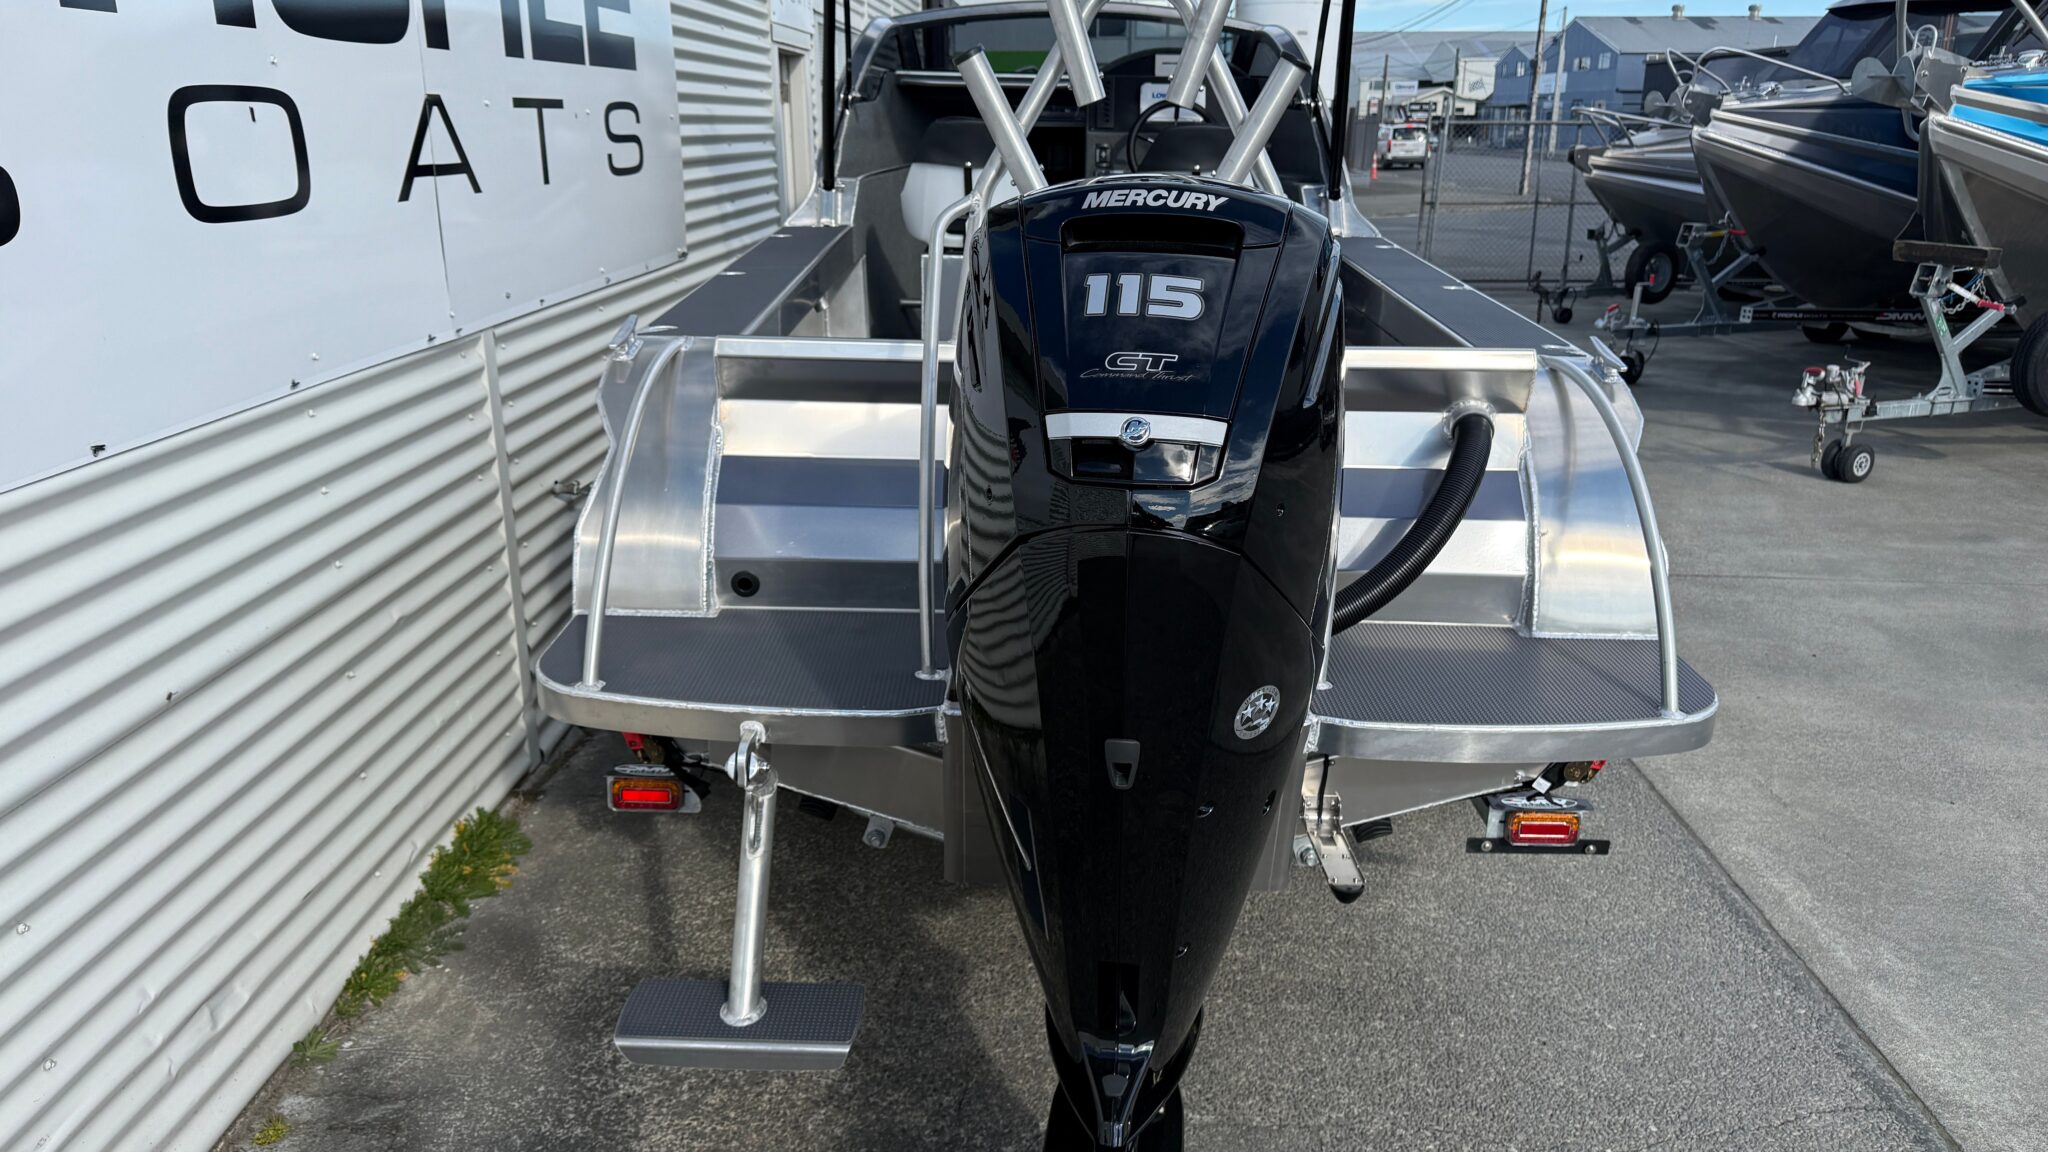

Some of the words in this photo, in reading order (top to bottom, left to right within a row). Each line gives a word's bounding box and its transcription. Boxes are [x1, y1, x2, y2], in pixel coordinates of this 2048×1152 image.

[0, 84, 644, 247] OATS
[1081, 188, 1230, 212] MERCURY
[1084, 272, 1205, 321] 115
[1079, 367, 1150, 379] Command
[1150, 369, 1194, 382] Thrust
